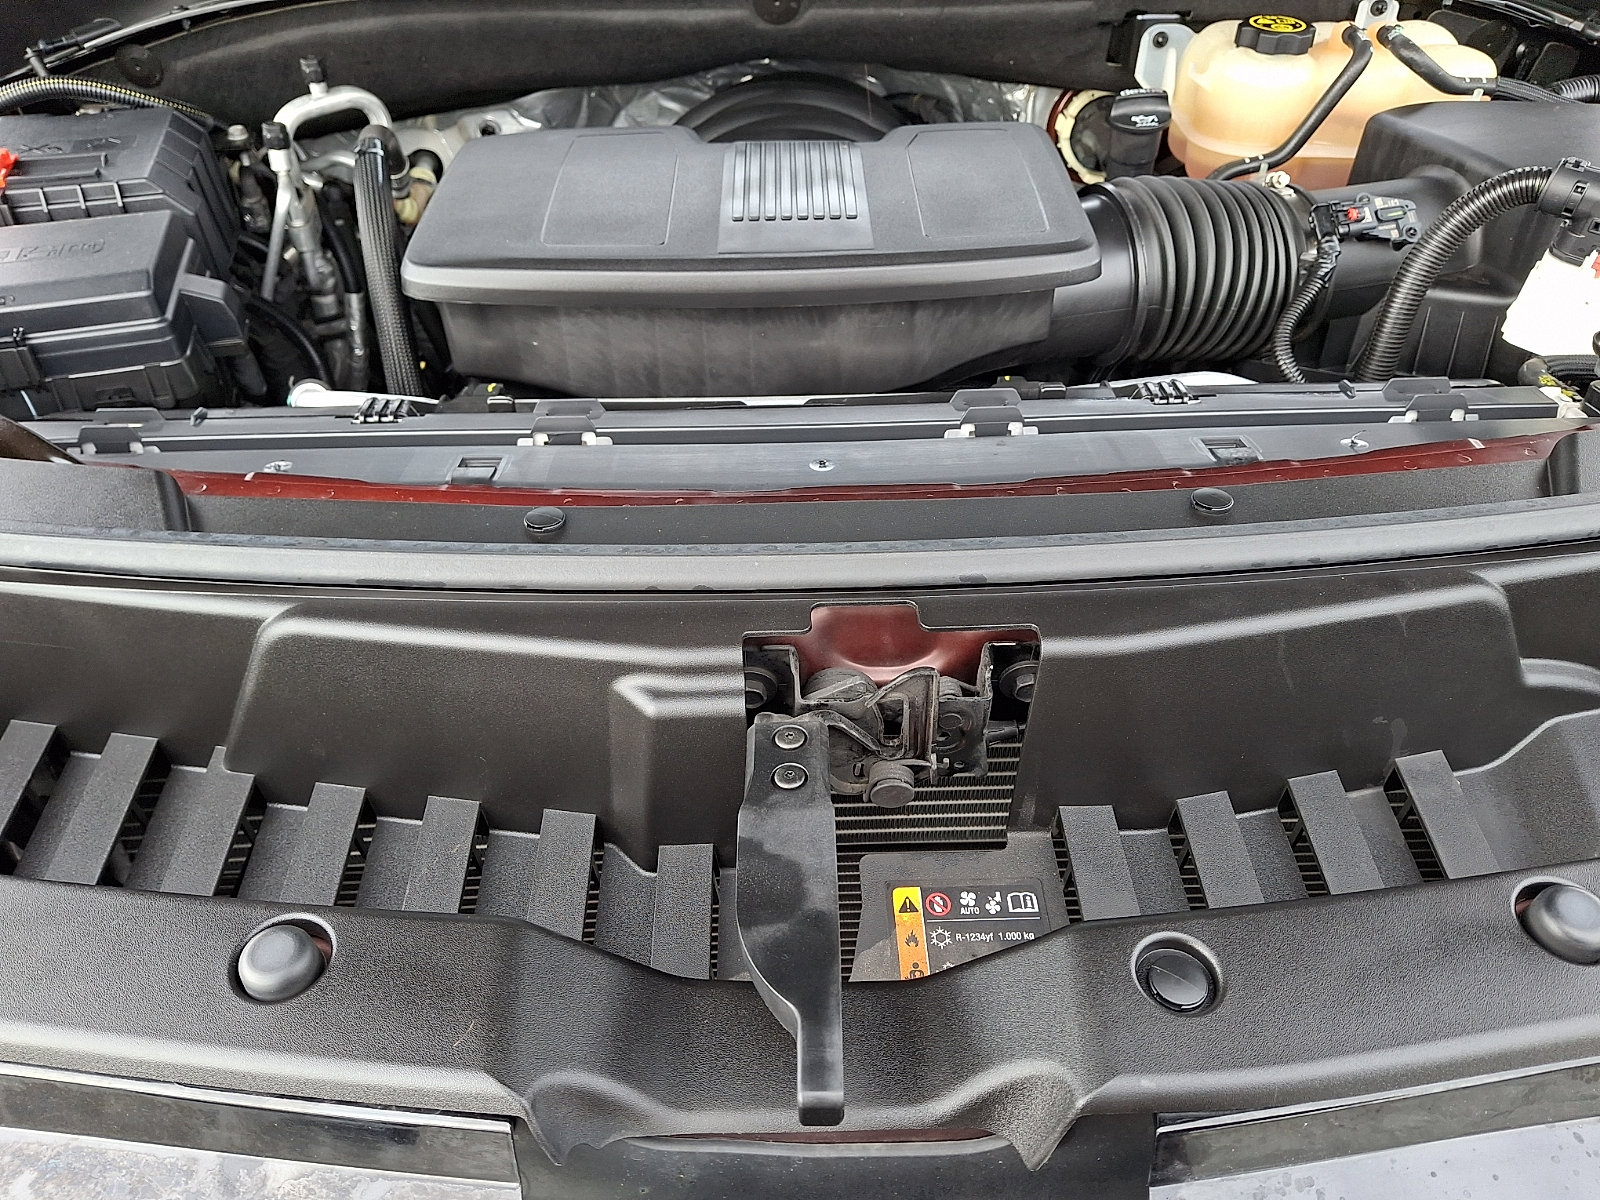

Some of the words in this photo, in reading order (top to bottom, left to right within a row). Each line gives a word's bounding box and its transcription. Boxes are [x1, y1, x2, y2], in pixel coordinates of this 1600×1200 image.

[960, 906, 980, 915] AUTO
[955, 932, 994, 943] R-1234yf
[998, 931, 1022, 941] 1.000
